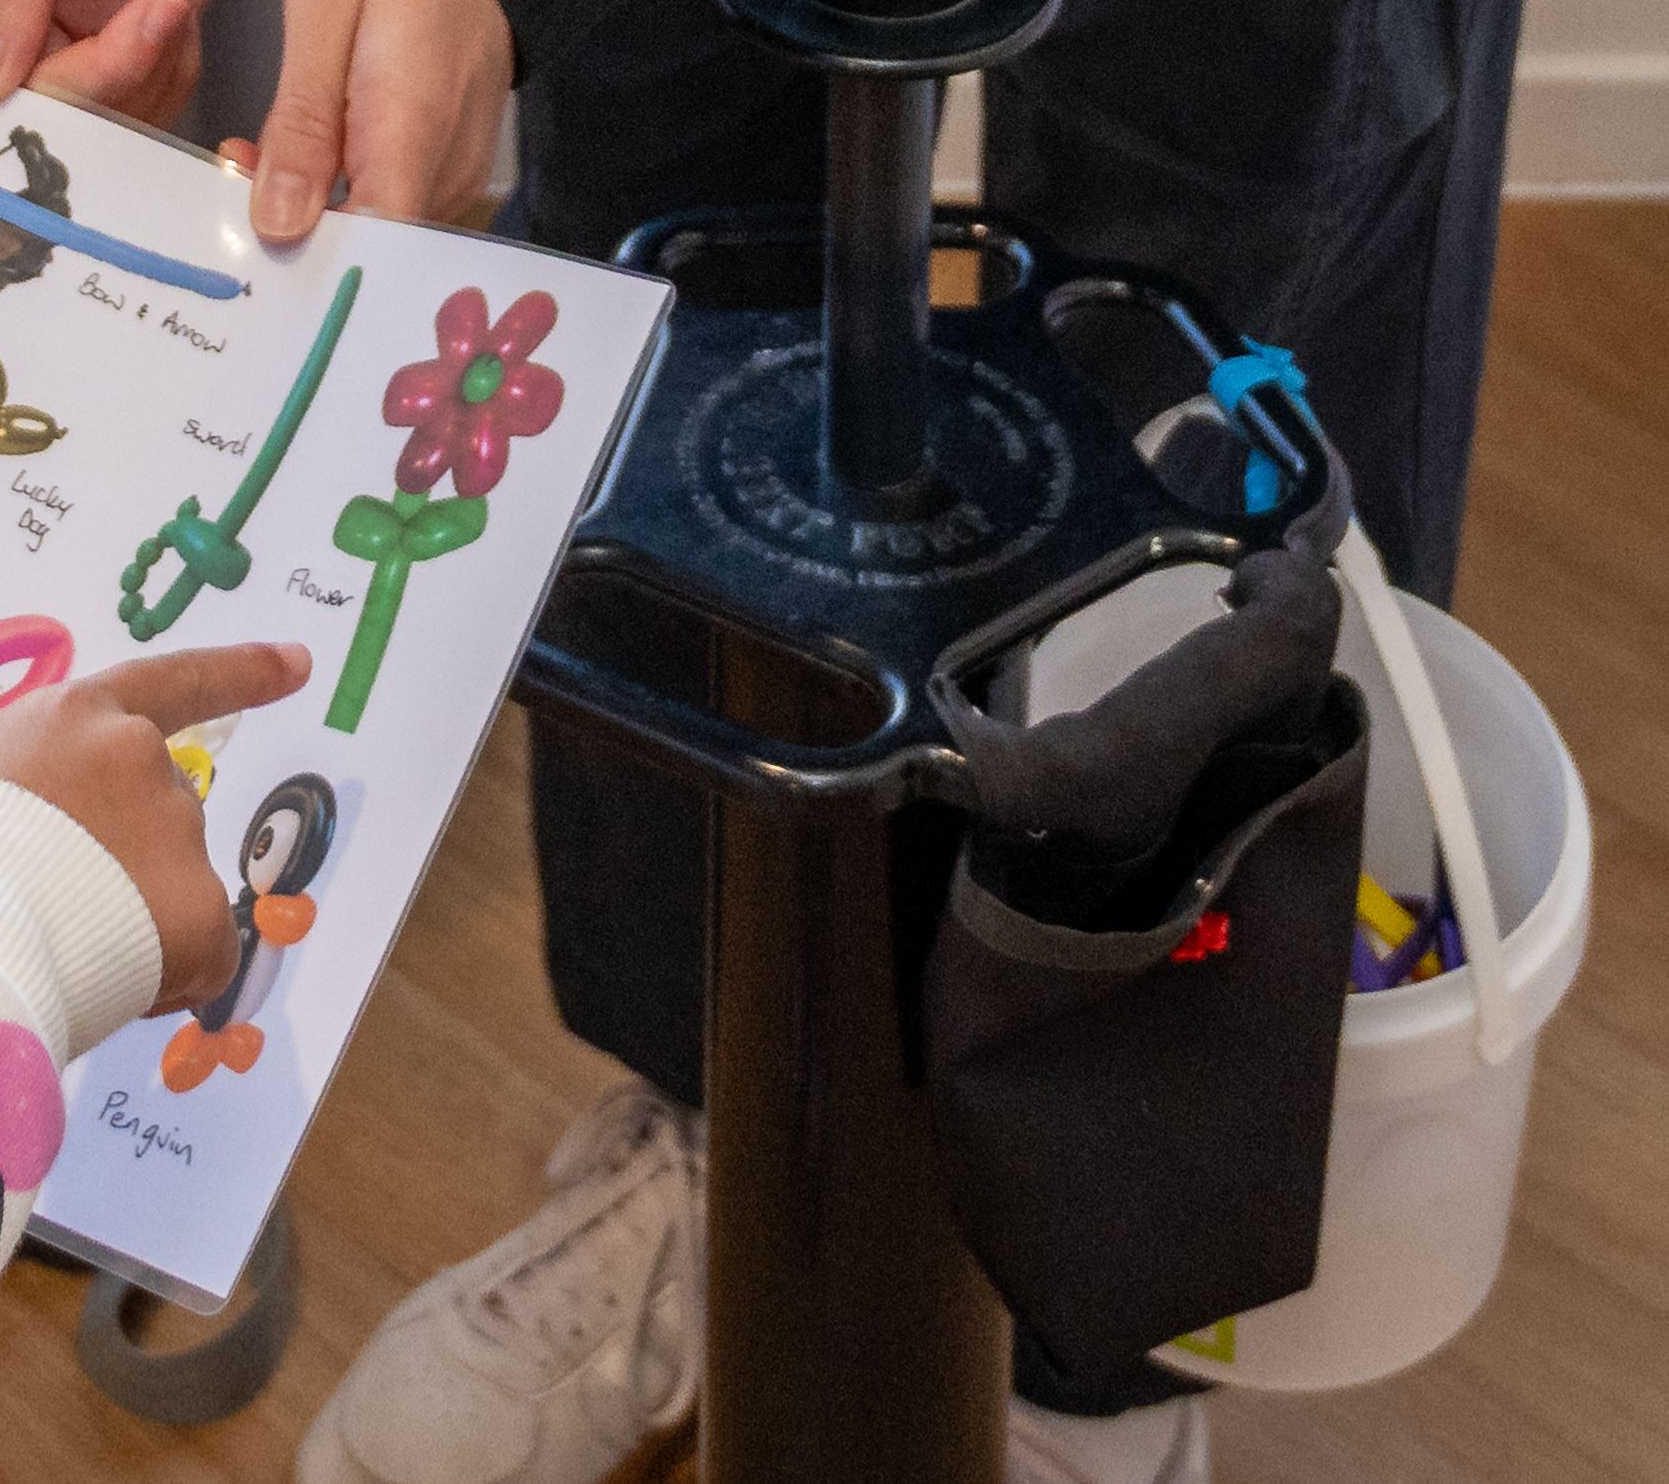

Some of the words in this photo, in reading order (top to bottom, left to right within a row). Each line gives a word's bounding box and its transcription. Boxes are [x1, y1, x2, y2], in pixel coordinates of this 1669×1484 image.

[77, 272, 126, 311] Bow
[161, 310, 227, 353] Arrow
[17, 506, 51, 553] Dog
[285, 567, 355, 607] Flower
[98, 1090, 193, 1165] Penguin
